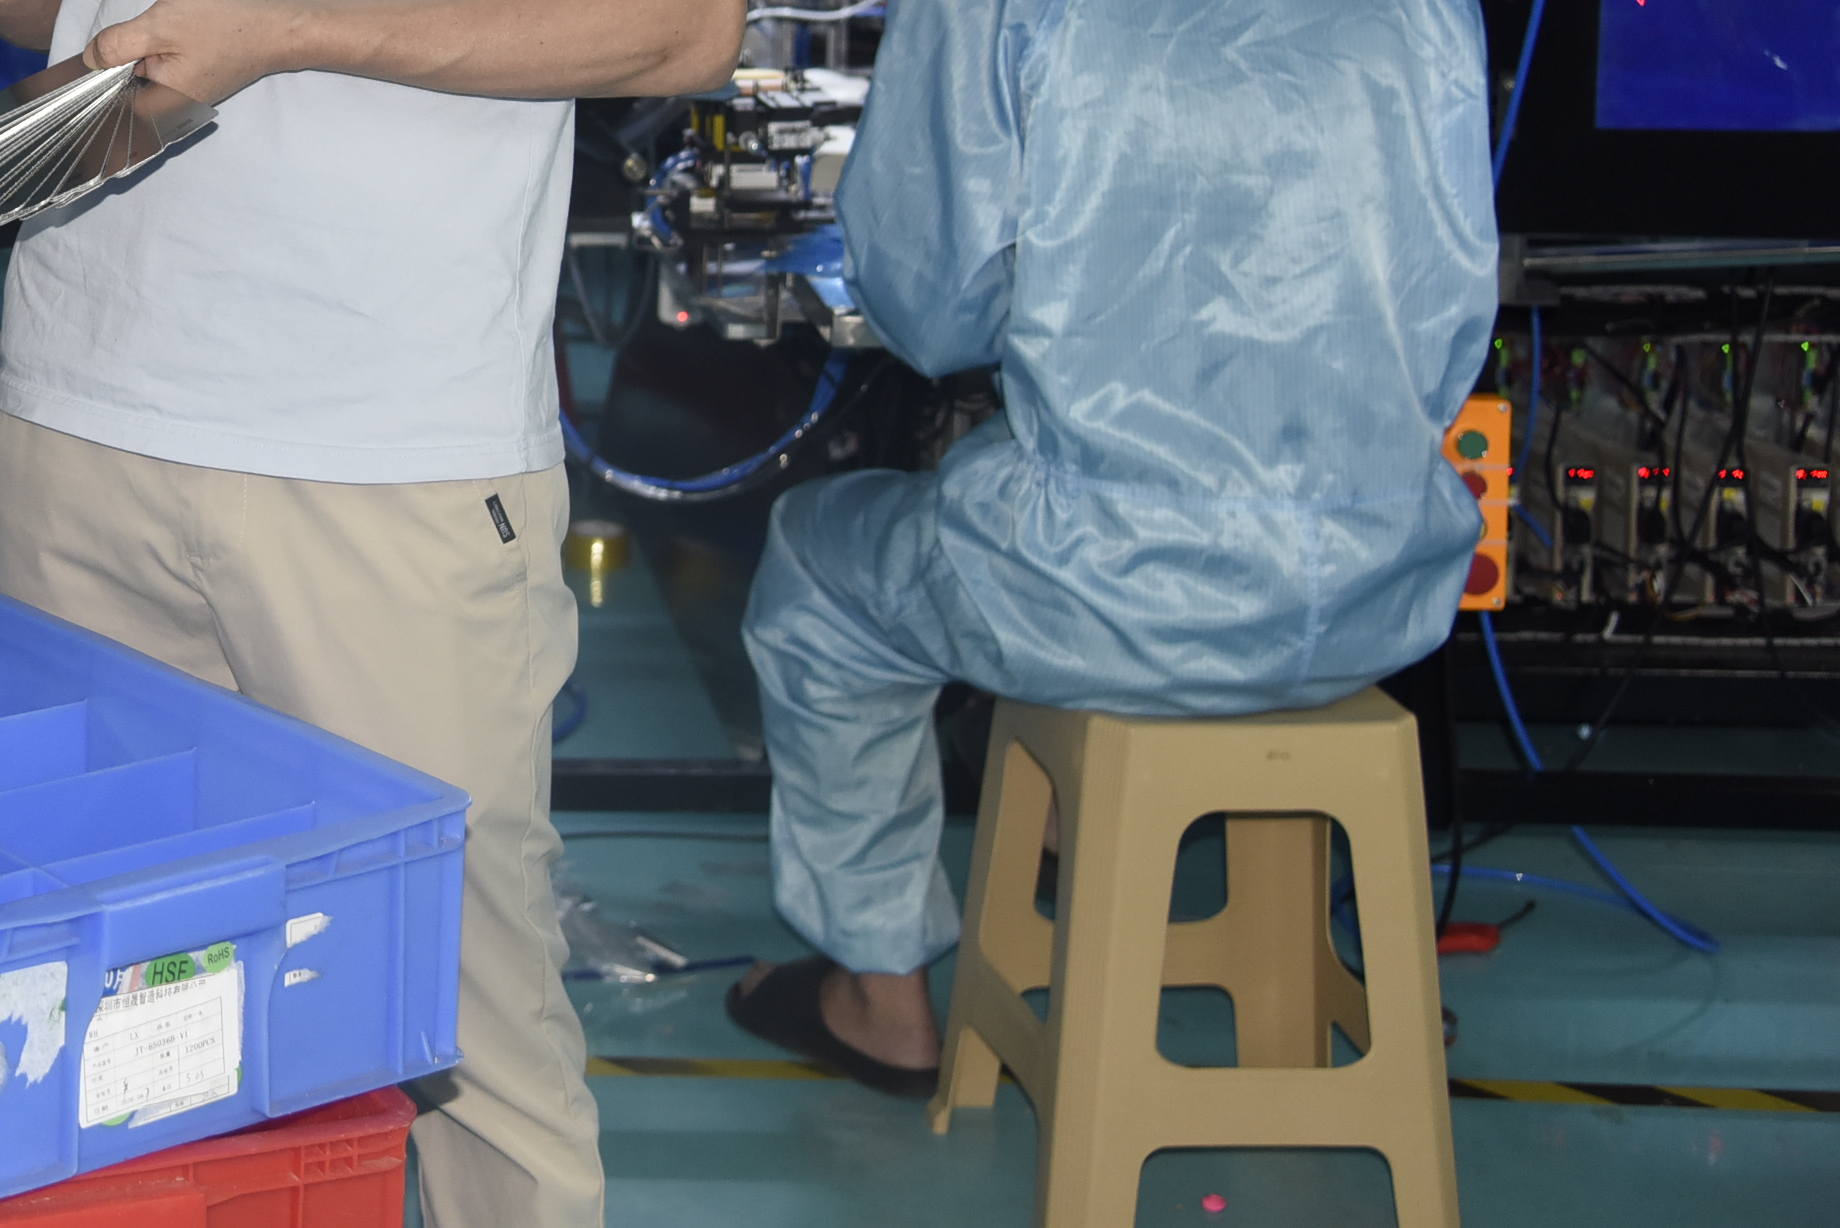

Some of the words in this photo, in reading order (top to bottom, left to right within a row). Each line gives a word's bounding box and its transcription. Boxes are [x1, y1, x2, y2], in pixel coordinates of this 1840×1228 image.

[207, 946, 230, 964] RoHS
[151, 960, 189, 985] HSF
[185, 1036, 215, 1053] 1200PCS
